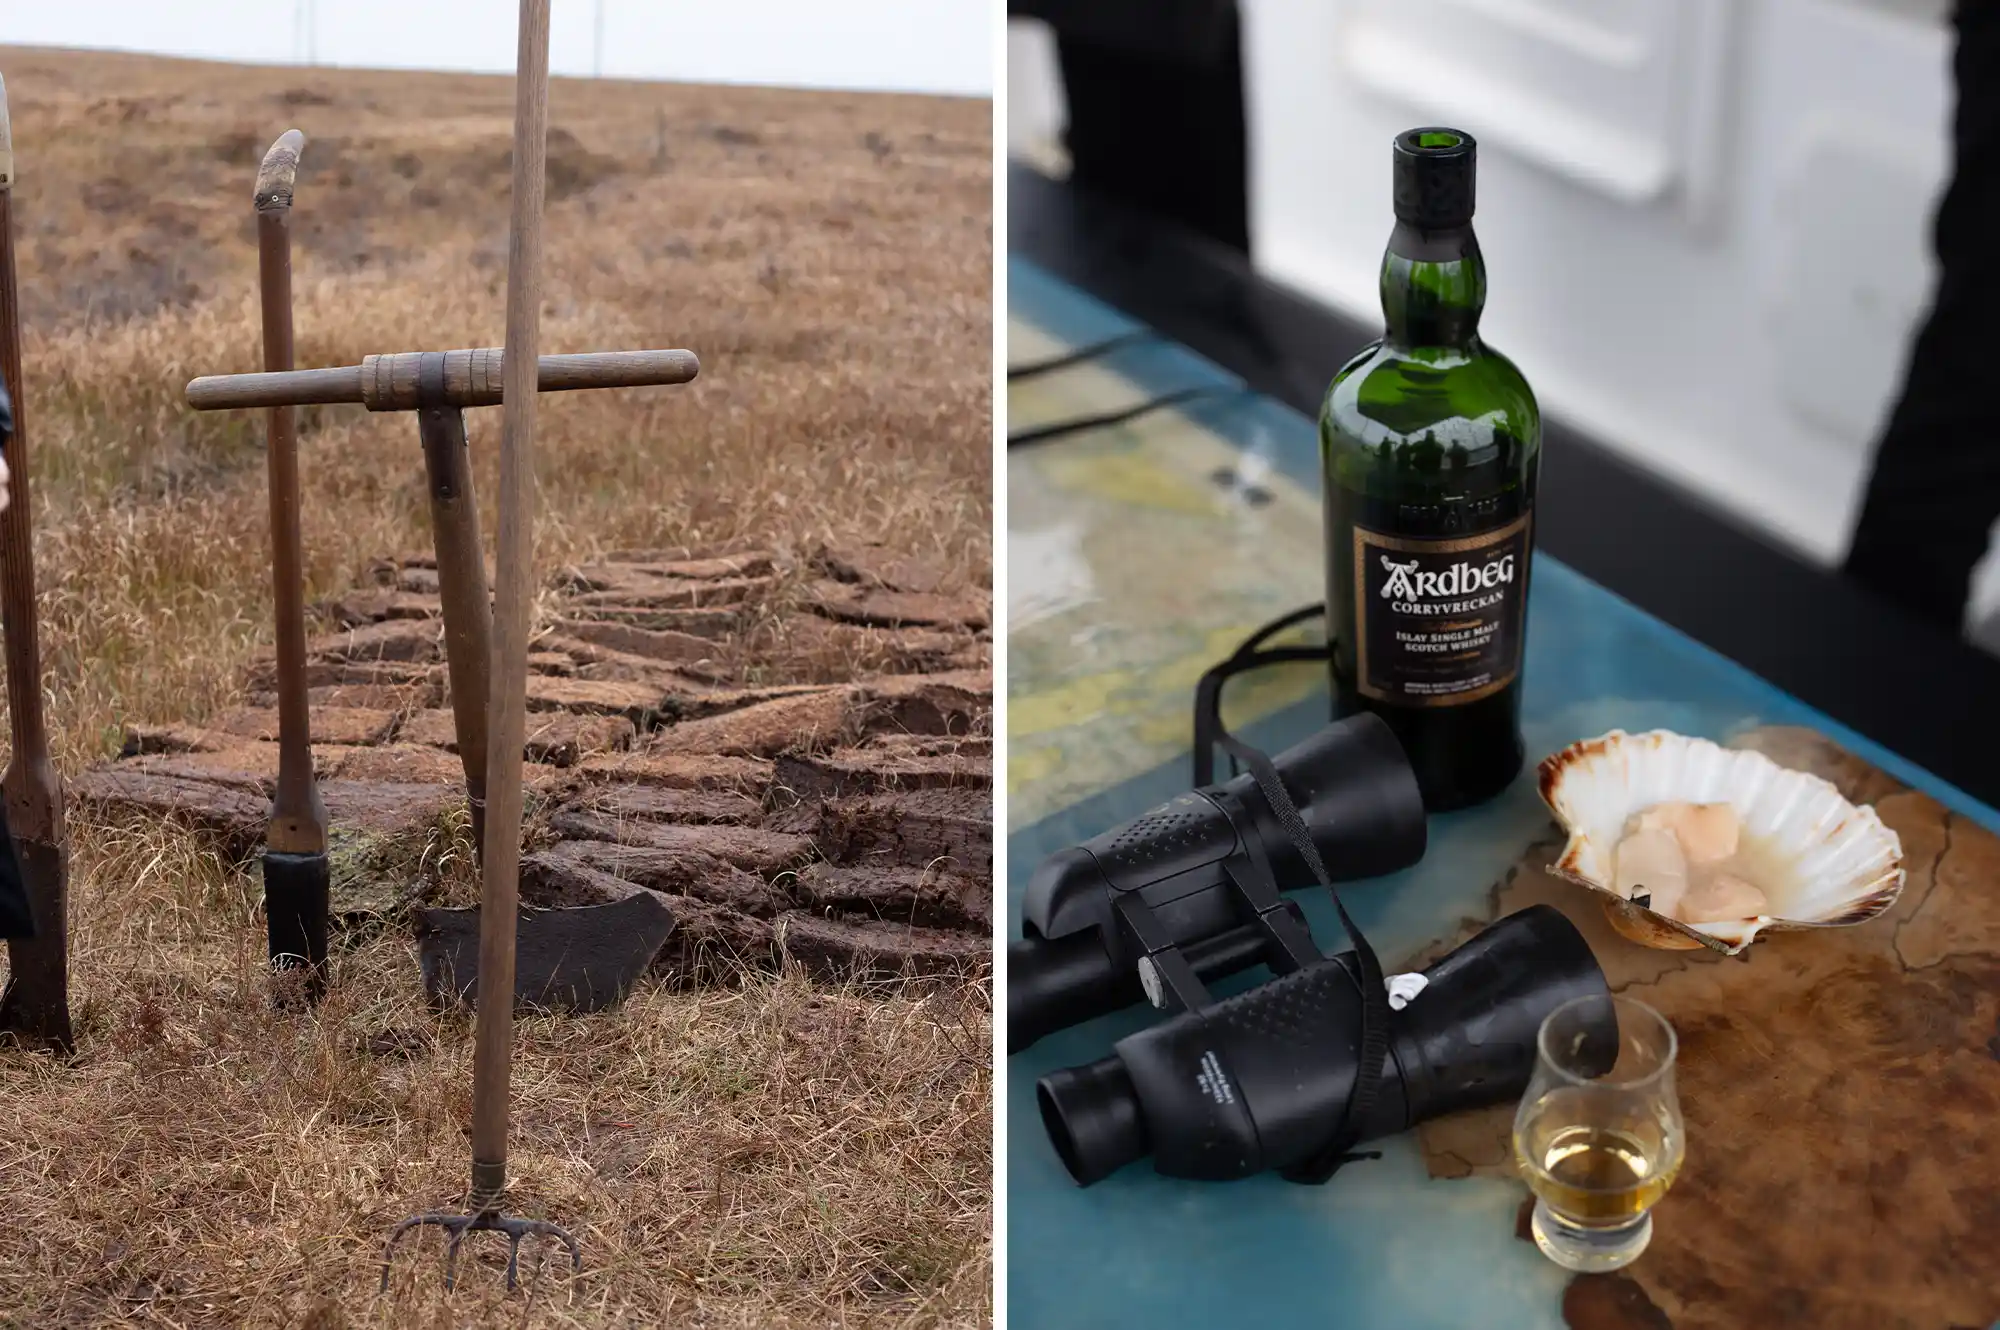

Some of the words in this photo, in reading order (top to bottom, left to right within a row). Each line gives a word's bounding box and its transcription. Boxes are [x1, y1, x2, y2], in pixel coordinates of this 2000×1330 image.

[1391, 588, 1504, 615] CORRYVRECKAN
[1396, 631, 1428, 642] ISLAY
[1430, 630, 1471, 643] SINGLE
[1473, 620, 1499, 636] MALT
[1404, 642, 1447, 652] SCOTCH
[1450, 635, 1491, 651] WHISKY
